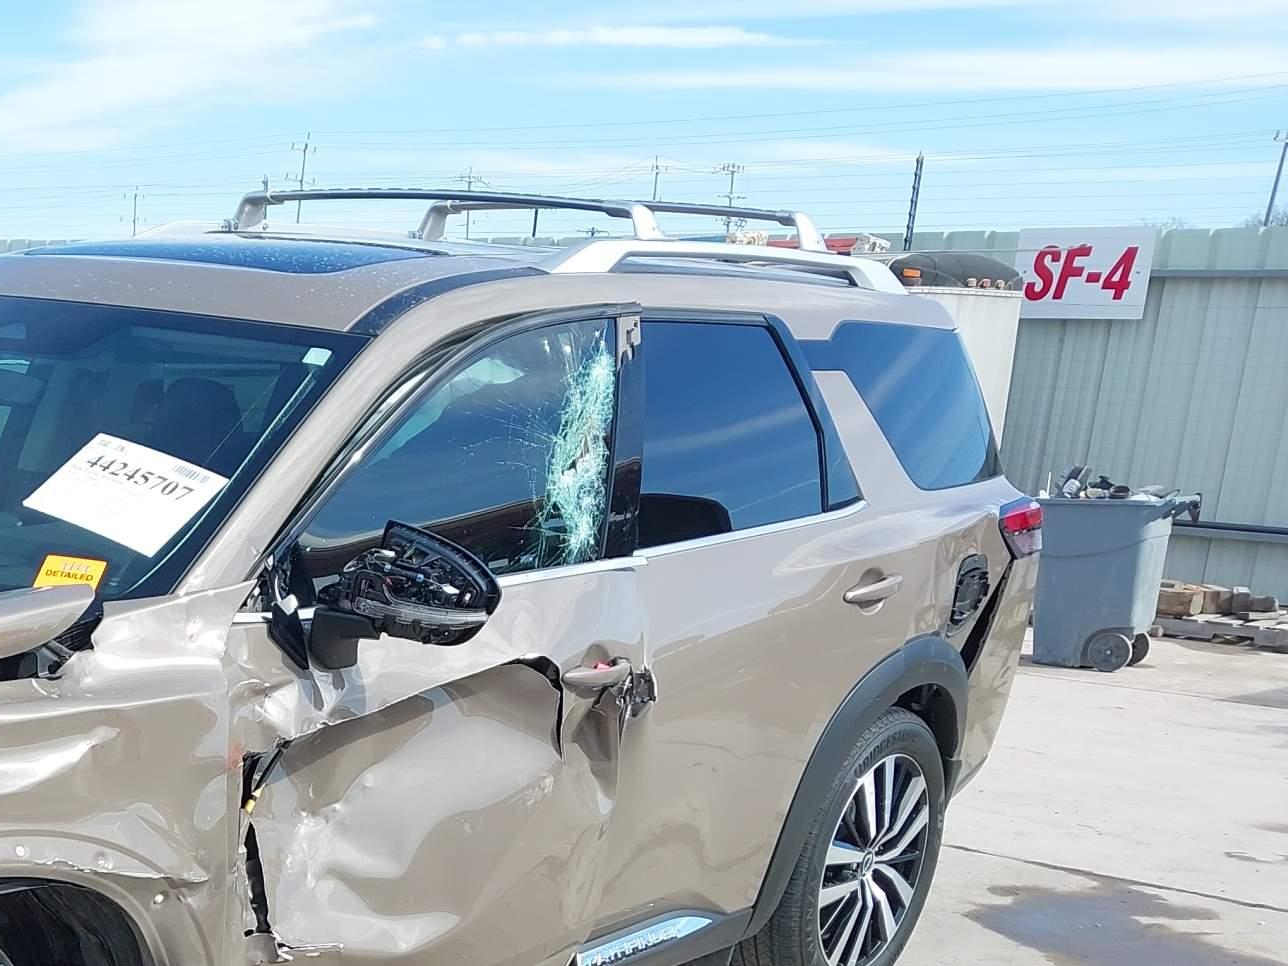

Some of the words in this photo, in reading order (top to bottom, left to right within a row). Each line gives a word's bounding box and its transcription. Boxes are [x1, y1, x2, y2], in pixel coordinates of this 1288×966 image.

[1024, 244, 1140, 302] SF-4
[87, 455, 195, 501] 44245707
[45, 568, 94, 582] DETAILED
